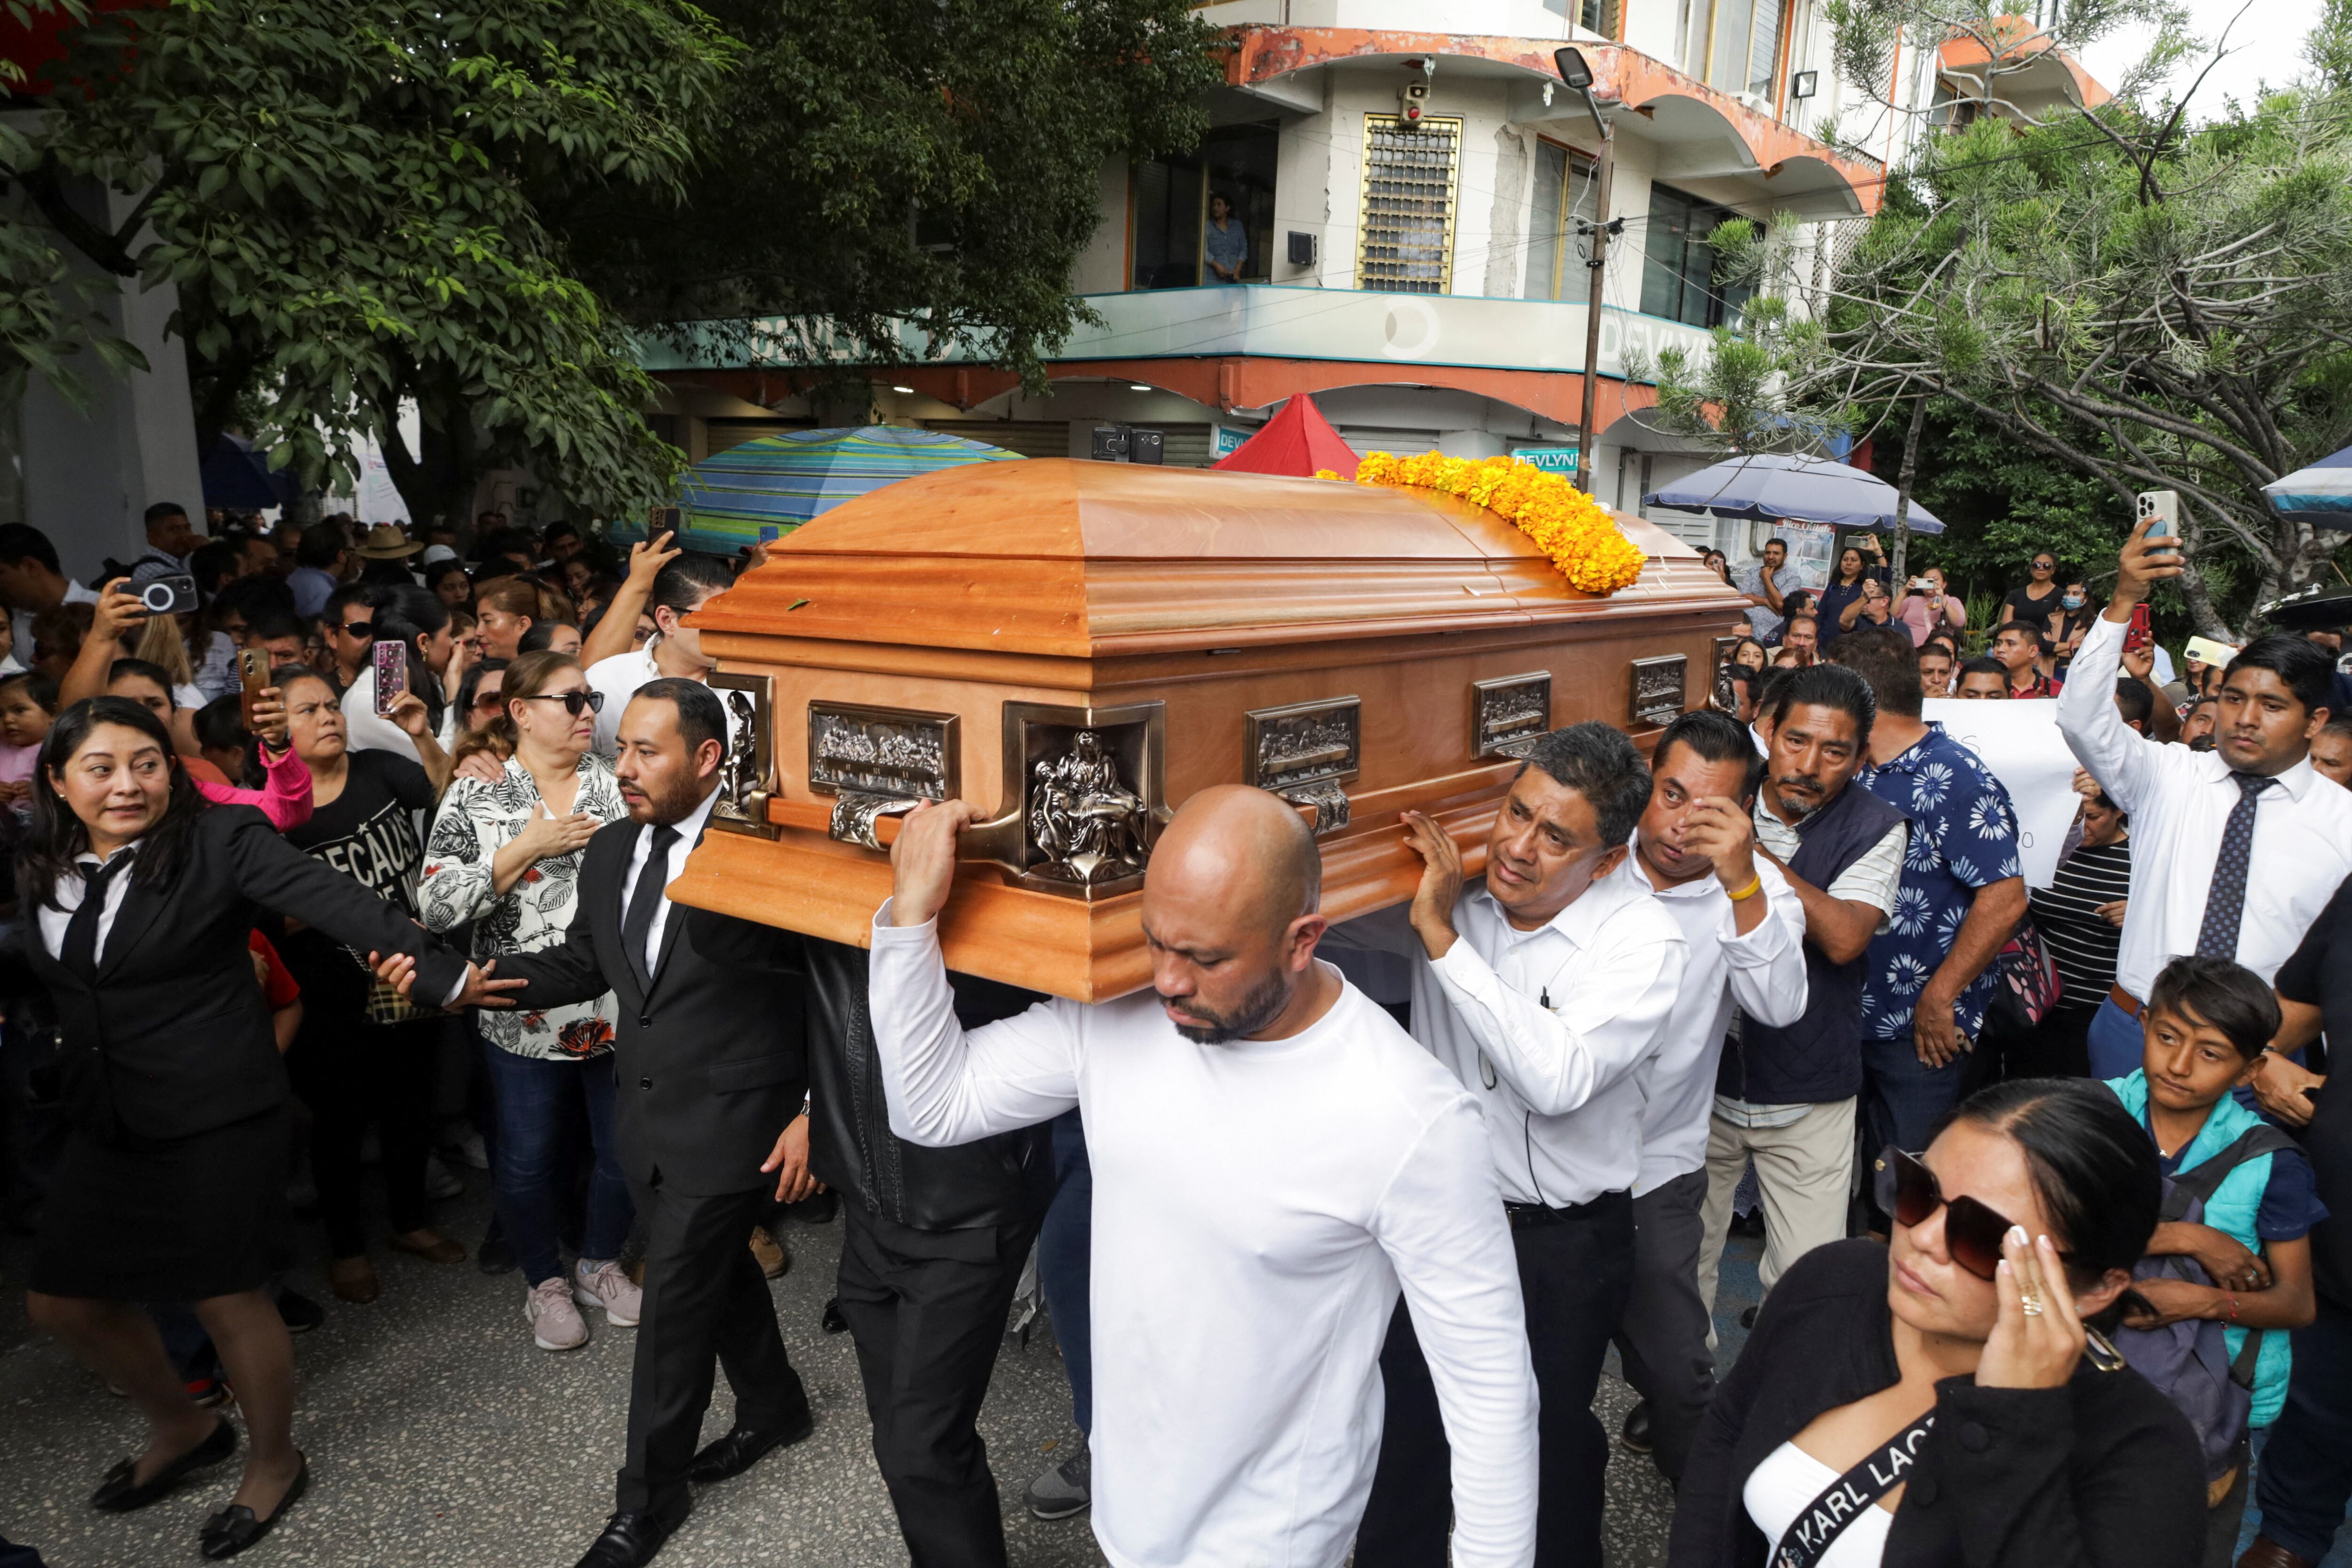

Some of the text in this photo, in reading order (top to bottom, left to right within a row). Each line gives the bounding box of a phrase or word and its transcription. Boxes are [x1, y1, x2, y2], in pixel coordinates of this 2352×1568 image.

[1220, 434, 1248, 449] DEV
[1515, 454, 1574, 467] DEVLYN
[1782, 518, 1800, 531] Rico
[312, 807, 418, 888] ECAUS
[1796, 1417, 1935, 1554] KARL LA
